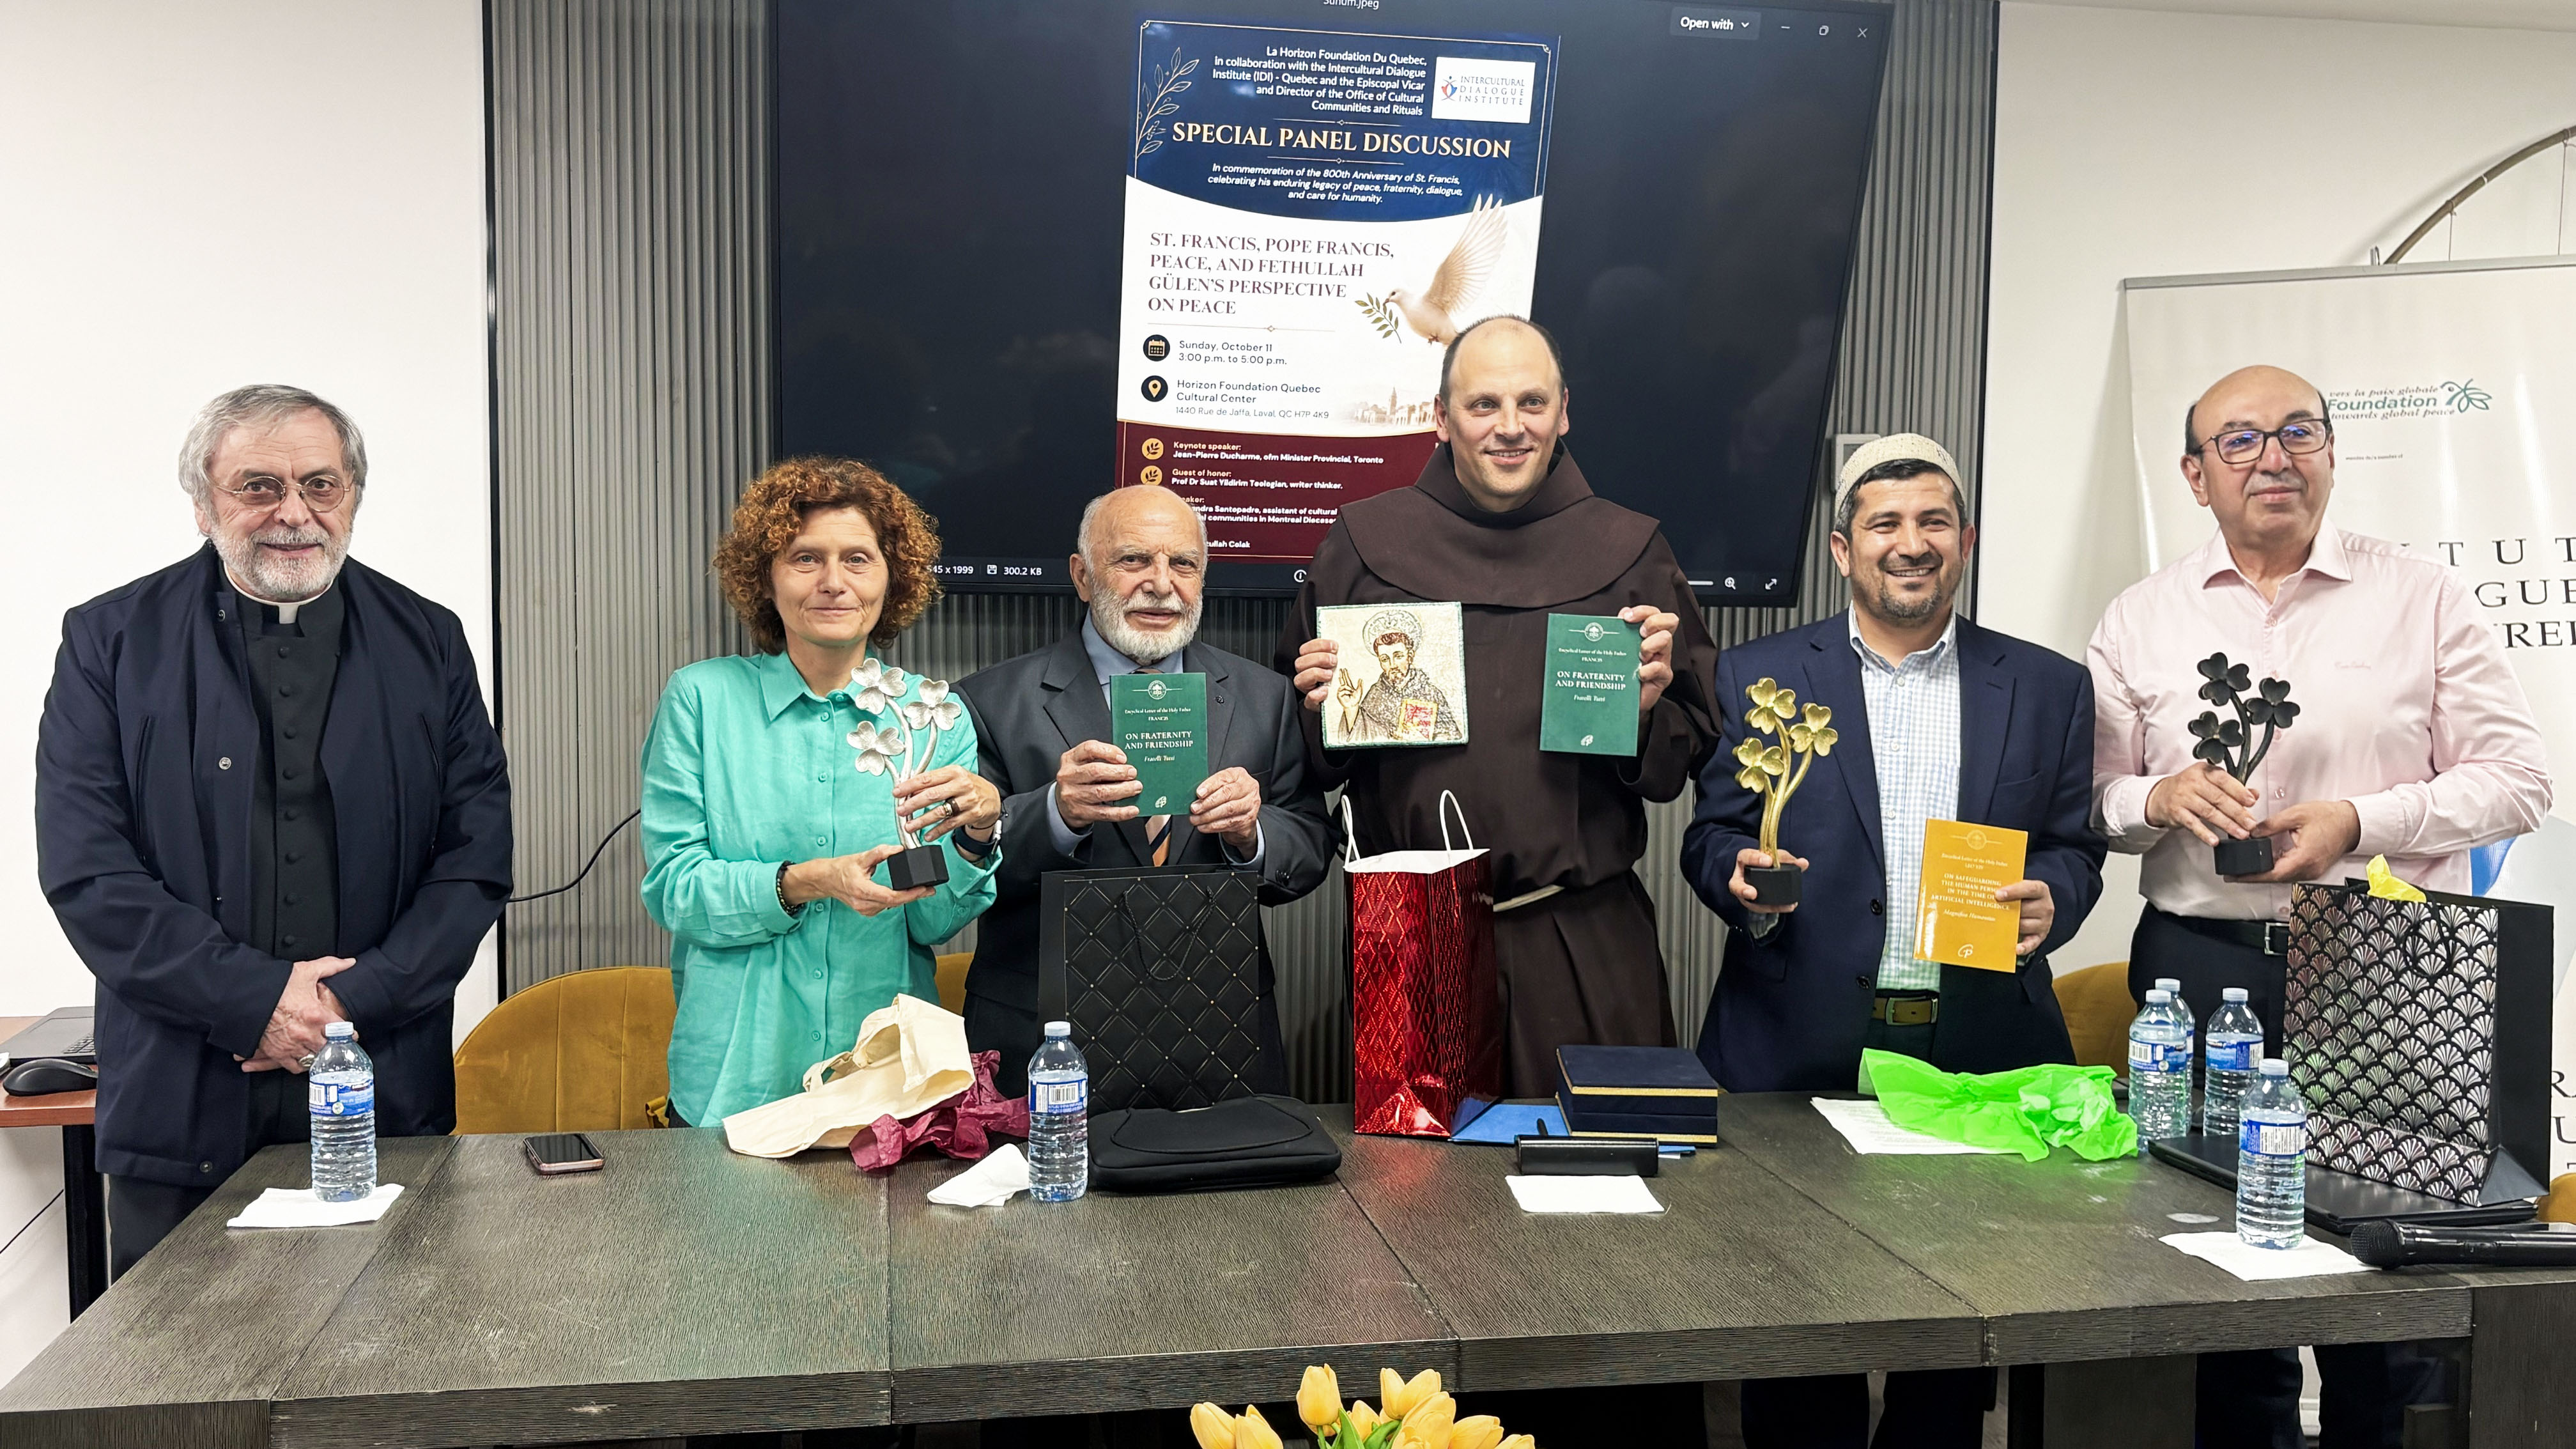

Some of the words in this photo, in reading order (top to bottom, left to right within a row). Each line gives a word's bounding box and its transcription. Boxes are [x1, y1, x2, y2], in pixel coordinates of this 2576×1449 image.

[1680, 17, 1709, 31] Open
[1711, 19, 1734, 31] with
[1267, 46, 1277, 56] La
[1280, 47, 1316, 58] Horizon
[1319, 49, 1371, 61] Foundation
[1373, 53, 1387, 63] Du
[1389, 54, 1426, 66] Quebec,
[1215, 56, 1223, 65] in
[1226, 57, 1285, 69] collaboration
[1288, 61, 1307, 70] with
[1311, 61, 1325, 72] the
[1329, 63, 1383, 75] Intercultural
[1386, 66, 1426, 78] Dialogue
[1214, 69, 1251, 80] Institute
[1254, 71, 1273, 83] (IDI)
[1282, 73, 1317, 84] Quebec
[1320, 76, 1337, 85] and
[1340, 77, 1354, 86] the
[1357, 77, 1399, 90] Episcopal
[1402, 80, 1424, 90] Vicar
[1461, 76, 1525, 86] INTERCULTURAL
[1256, 85, 1274, 95] and
[1276, 86, 1314, 97] Director
[1316, 88, 1326, 97] of
[1329, 89, 1343, 98] the
[1346, 89, 1374, 100] Office
[1377, 91, 1386, 101] of
[1388, 92, 1424, 103] Cultural
[1460, 86, 1523, 95] DIALOGUE
[1460, 96, 1522, 105] INSTITUTE
[1312, 100, 1371, 112] Communities
[1373, 104, 1390, 113] and
[1392, 105, 1423, 115] Rituals
[1173, 123, 1272, 146] SPECIAL
[1279, 128, 1357, 150] PANEL
[1364, 133, 1511, 158] DISCUSSION
[1223, 166, 1293, 176] commemoration
[1296, 168, 1305, 176] of
[1307, 169, 1321, 177] the
[1323, 169, 1350, 178] 800th
[1352, 171, 1403, 183] Anniversary
[1405, 173, 1414, 182] of
[1415, 174, 1425, 182] St.
[1428, 174, 1460, 185] Francis,
[1208, 176, 1256, 187] celebrating
[1258, 178, 1270, 186] his
[1273, 179, 1311, 190] enduring
[1313, 180, 1341, 192] legacy
[1343, 182, 1352, 190] of
[1353, 184, 1381, 192] peace,
[1384, 183, 1423, 195] fraternity,
[1426, 186, 1462, 197] dialogue,
[1328, 192, 1340, 200] for
[1342, 193, 1382, 205] humanity.
[1151, 233, 1175, 246] ST.
[1182, 235, 1260, 251] FRANCIS,
[1266, 238, 1311, 252] POPE
[1317, 241, 1393, 258] FRANCIS,
[1151, 254, 1211, 271] PEACE,
[1217, 258, 1253, 271] AND
[1259, 260, 1363, 276] FETHULLAH
[1230, 280, 1346, 297] PERSPECTIVE
[1148, 298, 1174, 311] ON
[1180, 299, 1235, 314] PEACE
[1180, 341, 1218, 352] Sunday,
[1222, 343, 1263, 351] October
[1179, 353, 1201, 361] 3:00
[1241, 355, 1263, 364] 5:00
[1178, 380, 1215, 389] Horizon
[1220, 382, 1277, 391] Foundation
[1281, 384, 1320, 392] Quebec
[1177, 392, 1217, 401] Cultural
[1221, 394, 1256, 403] Center
[2327, 395, 2437, 410] Foundation
[927, 565, 943, 574] 545
[1003, 566, 1028, 575] 300.2
[1573, 672, 1625, 681] FRATERNITY
[1576, 681, 1626, 690] FRIENDSHIP
[1141, 731, 1191, 740] FRATERNITY
[1145, 740, 1193, 748] FRIENDSHIP
